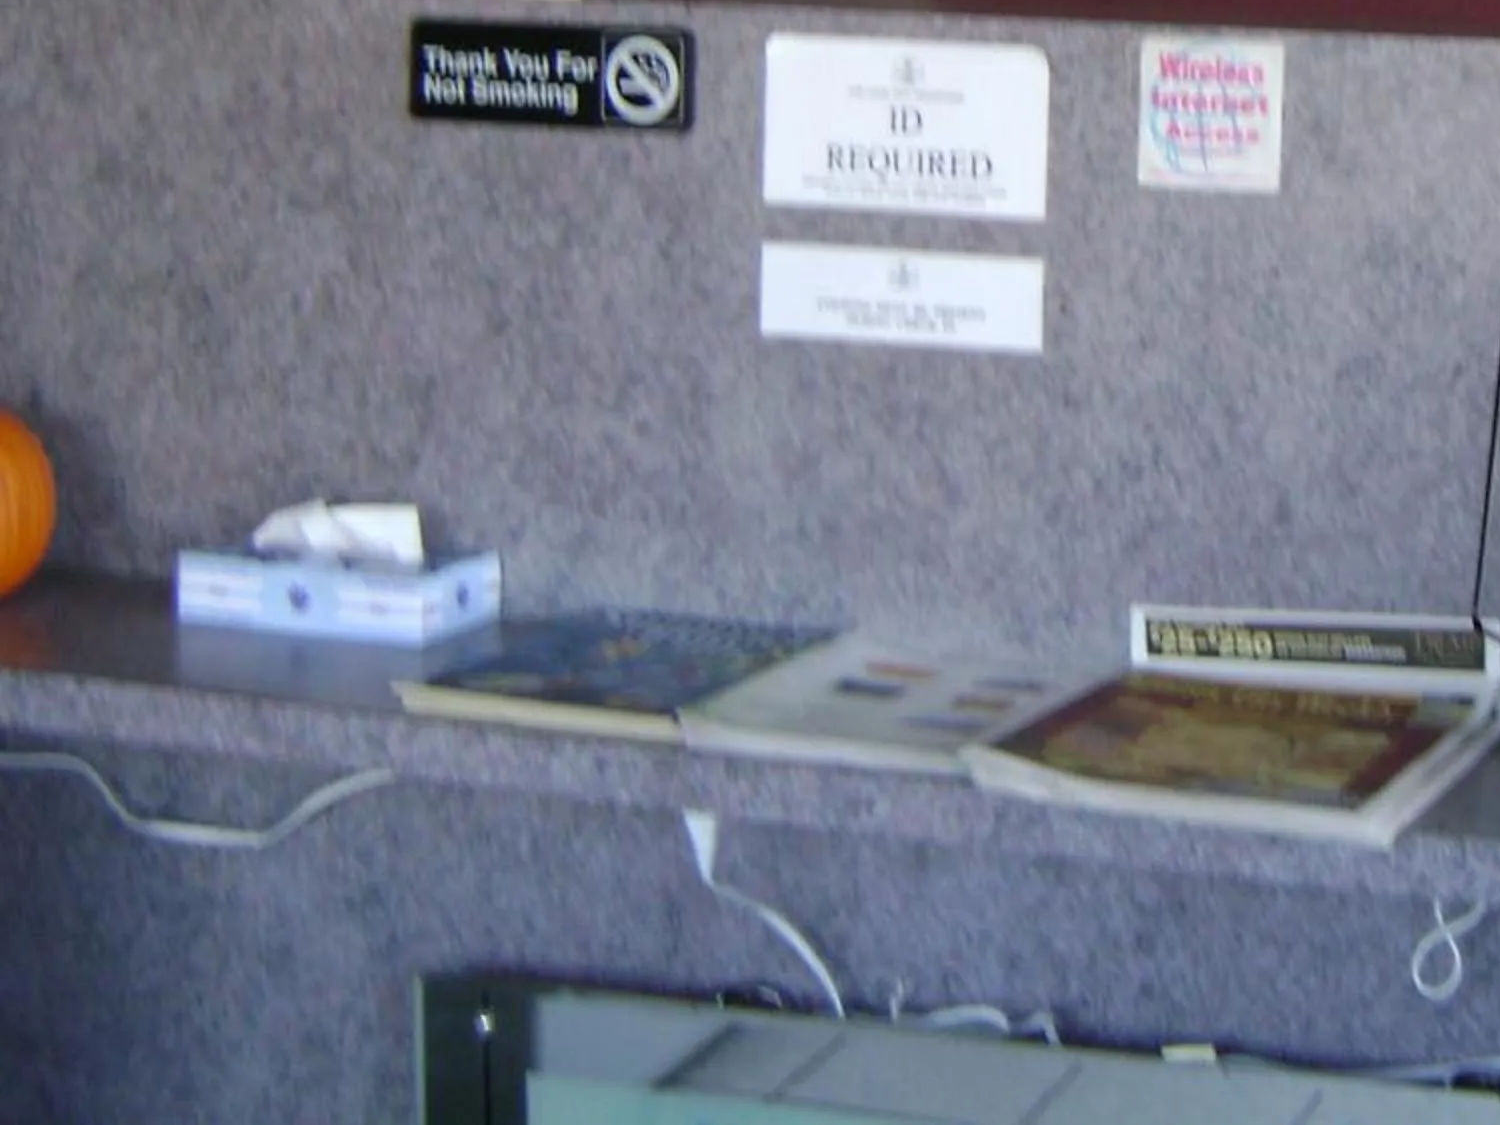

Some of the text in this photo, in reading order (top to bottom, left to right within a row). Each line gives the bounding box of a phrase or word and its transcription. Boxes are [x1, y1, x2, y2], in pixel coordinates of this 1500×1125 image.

[423, 43, 598, 83] Thank You For
[424, 74, 579, 116] Not Smoking
[890, 105, 923, 135] ID
[826, 143, 993, 184] REQUIRED
